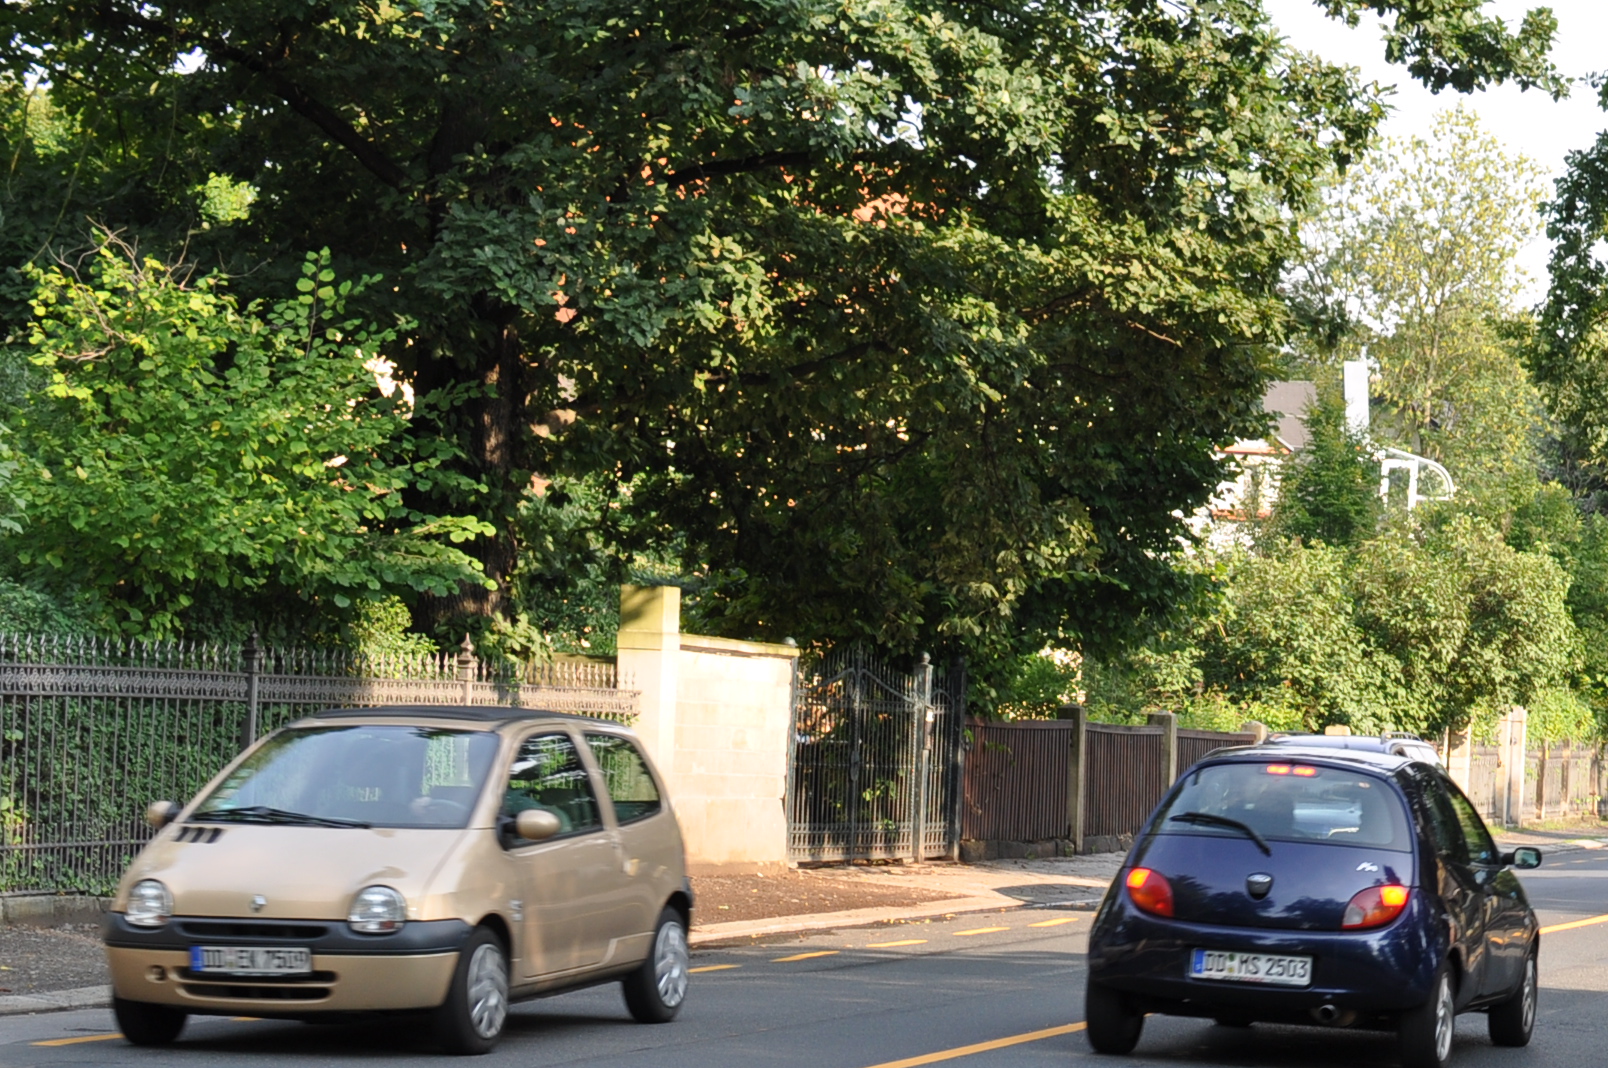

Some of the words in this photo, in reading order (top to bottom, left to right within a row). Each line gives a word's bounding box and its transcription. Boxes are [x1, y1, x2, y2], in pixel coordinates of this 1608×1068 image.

[203, 949, 224, 969] DD
[1205, 953, 1226, 973] DD
[1265, 957, 1310, 979] 2503
